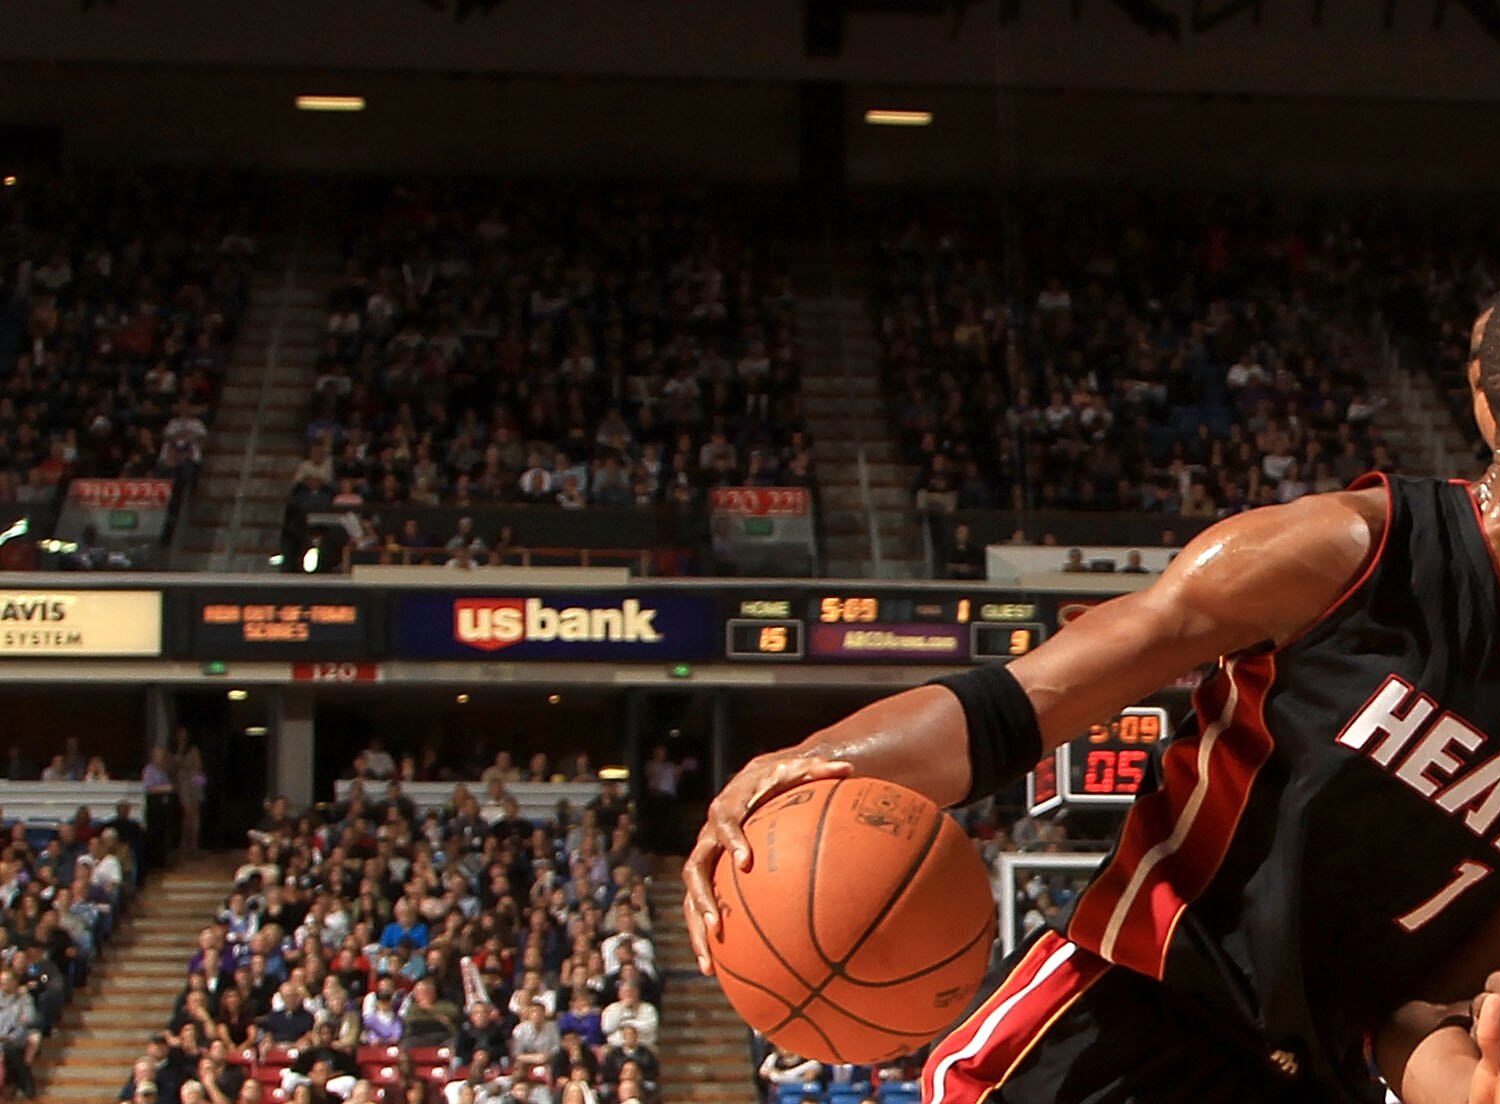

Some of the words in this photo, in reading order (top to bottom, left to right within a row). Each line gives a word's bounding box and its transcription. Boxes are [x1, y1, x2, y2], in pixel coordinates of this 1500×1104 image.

[741, 601, 790, 618] HOME
[981, 602, 1037, 621] GUEST
[5, 630, 83, 646] SYSTEM
[312, 662, 357, 683] 120
[1084, 750, 1148, 793] 05
[1393, 858, 1494, 933] 1
